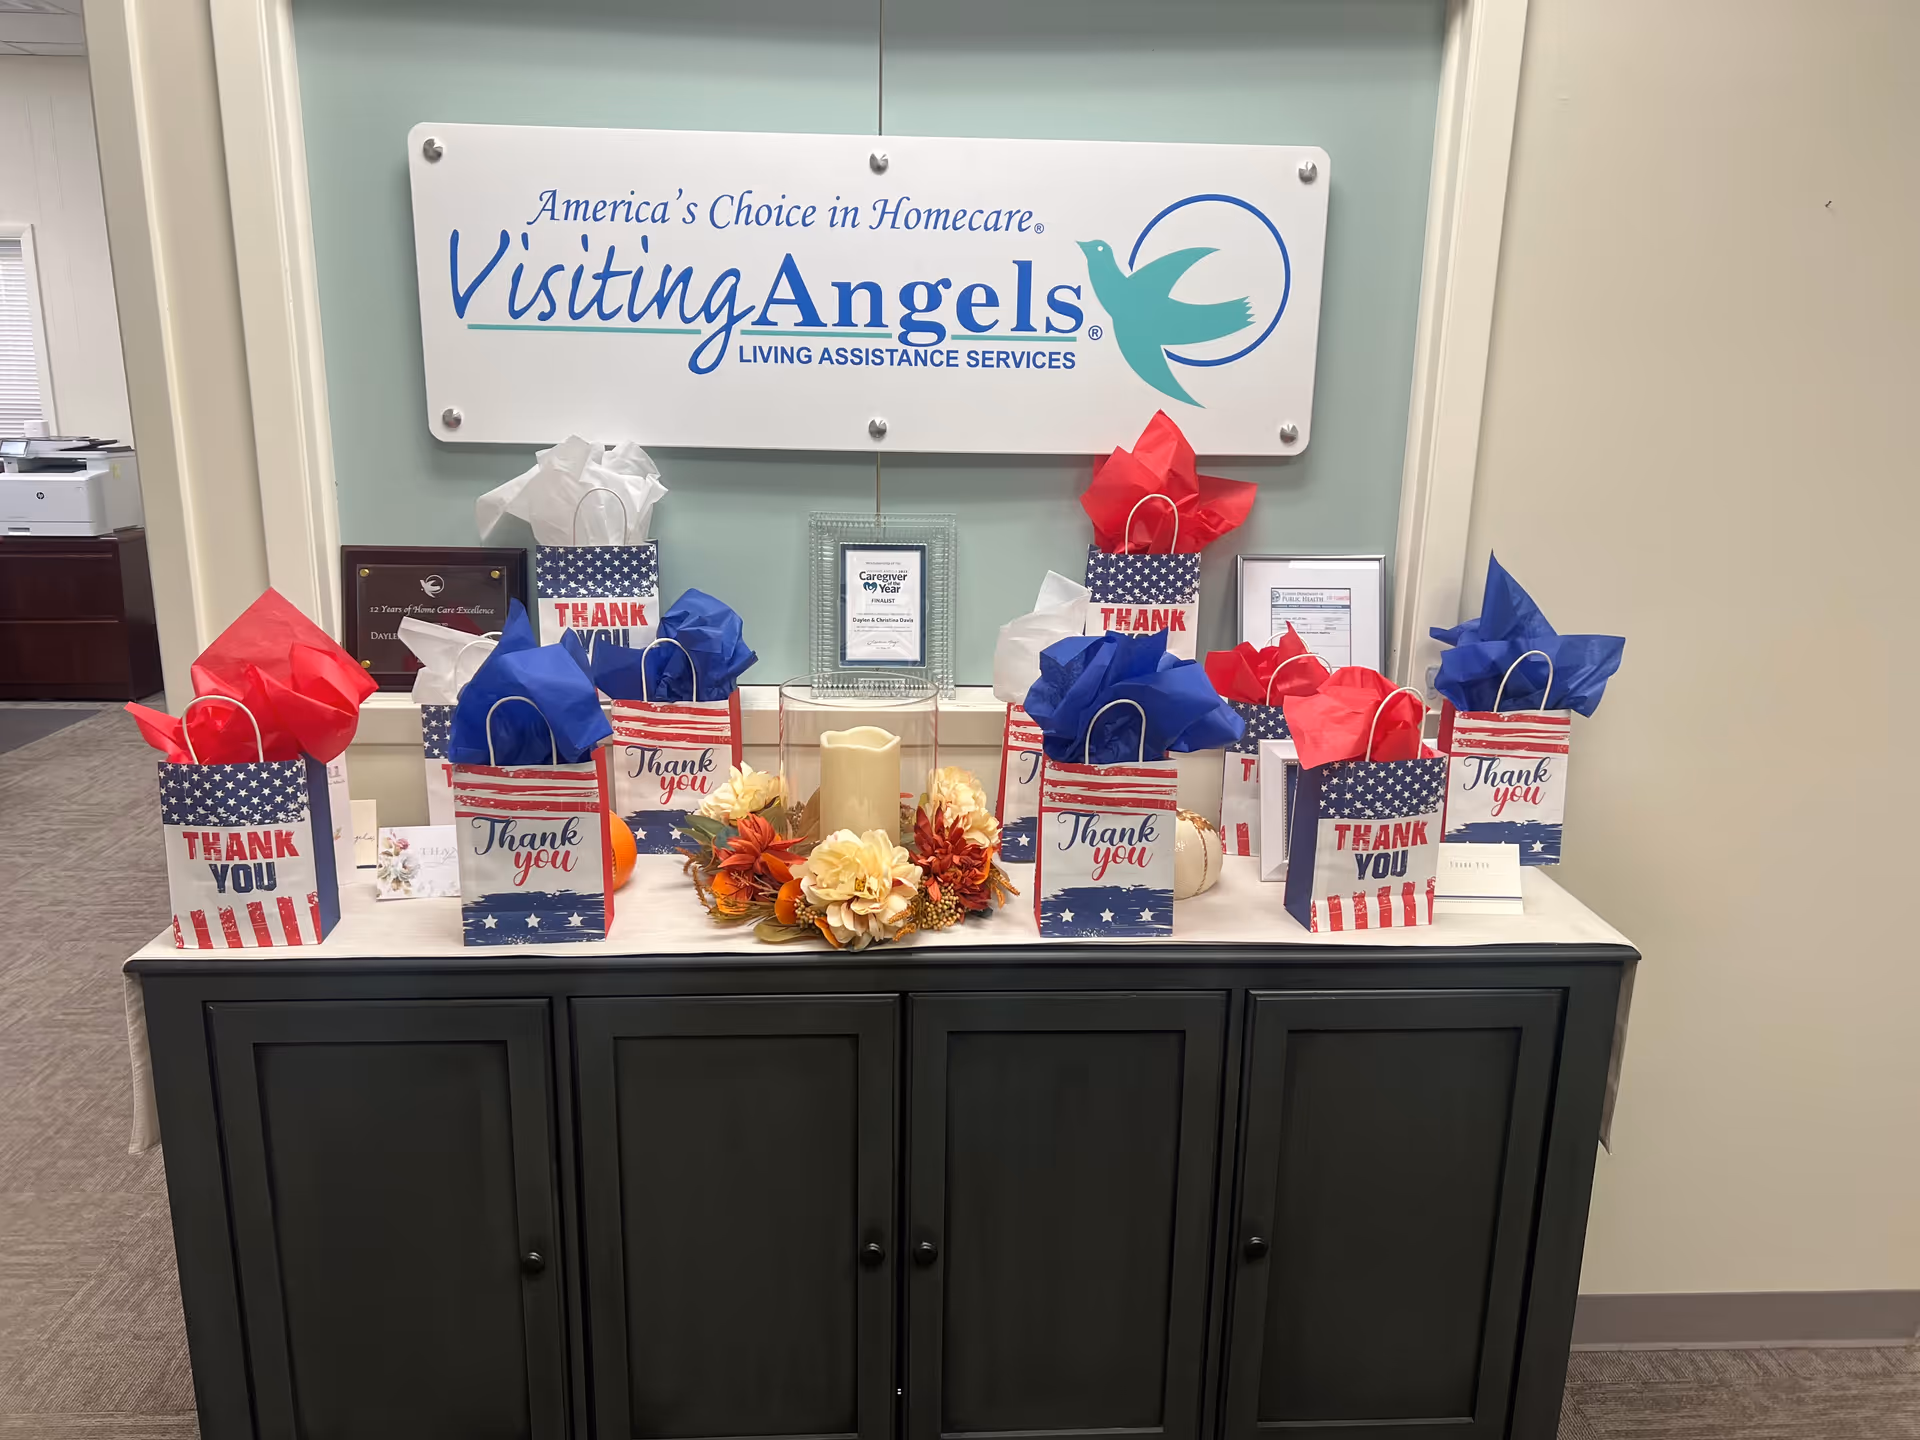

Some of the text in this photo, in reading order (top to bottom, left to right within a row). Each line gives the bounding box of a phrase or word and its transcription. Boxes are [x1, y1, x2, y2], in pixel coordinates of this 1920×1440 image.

[527, 188, 698, 225] America's
[708, 193, 817, 229] Choice
[828, 195, 860, 229] in
[449, 229, 756, 375] Visiting
[739, 345, 1077, 371] LIVING ASSISTANCE SERVICES
[859, 571, 907, 583] Caregiver
[878, 584, 901, 594] Year
[381, 605, 402, 613] Years
[403, 604, 413, 615] of
[413, 604, 435, 614] Home
[436, 606, 455, 614] Care
[456, 605, 495, 615] Excellence
[554, 602, 649, 628] THANK
[1100, 607, 1187, 632] THANK
[370, 631, 401, 640] DAYLE
[624, 744, 718, 779] Thank
[1462, 755, 1552, 791] Thank
[658, 772, 714, 805] you
[1490, 785, 1546, 816] you
[182, 829, 300, 861] THANK
[471, 816, 584, 856] Thank
[1057, 811, 1160, 851] Thank
[1334, 820, 1429, 851] THANK
[208, 862, 278, 894] YOU
[513, 848, 579, 886] you
[1091, 845, 1154, 881] you
[1354, 850, 1409, 880] YOU
